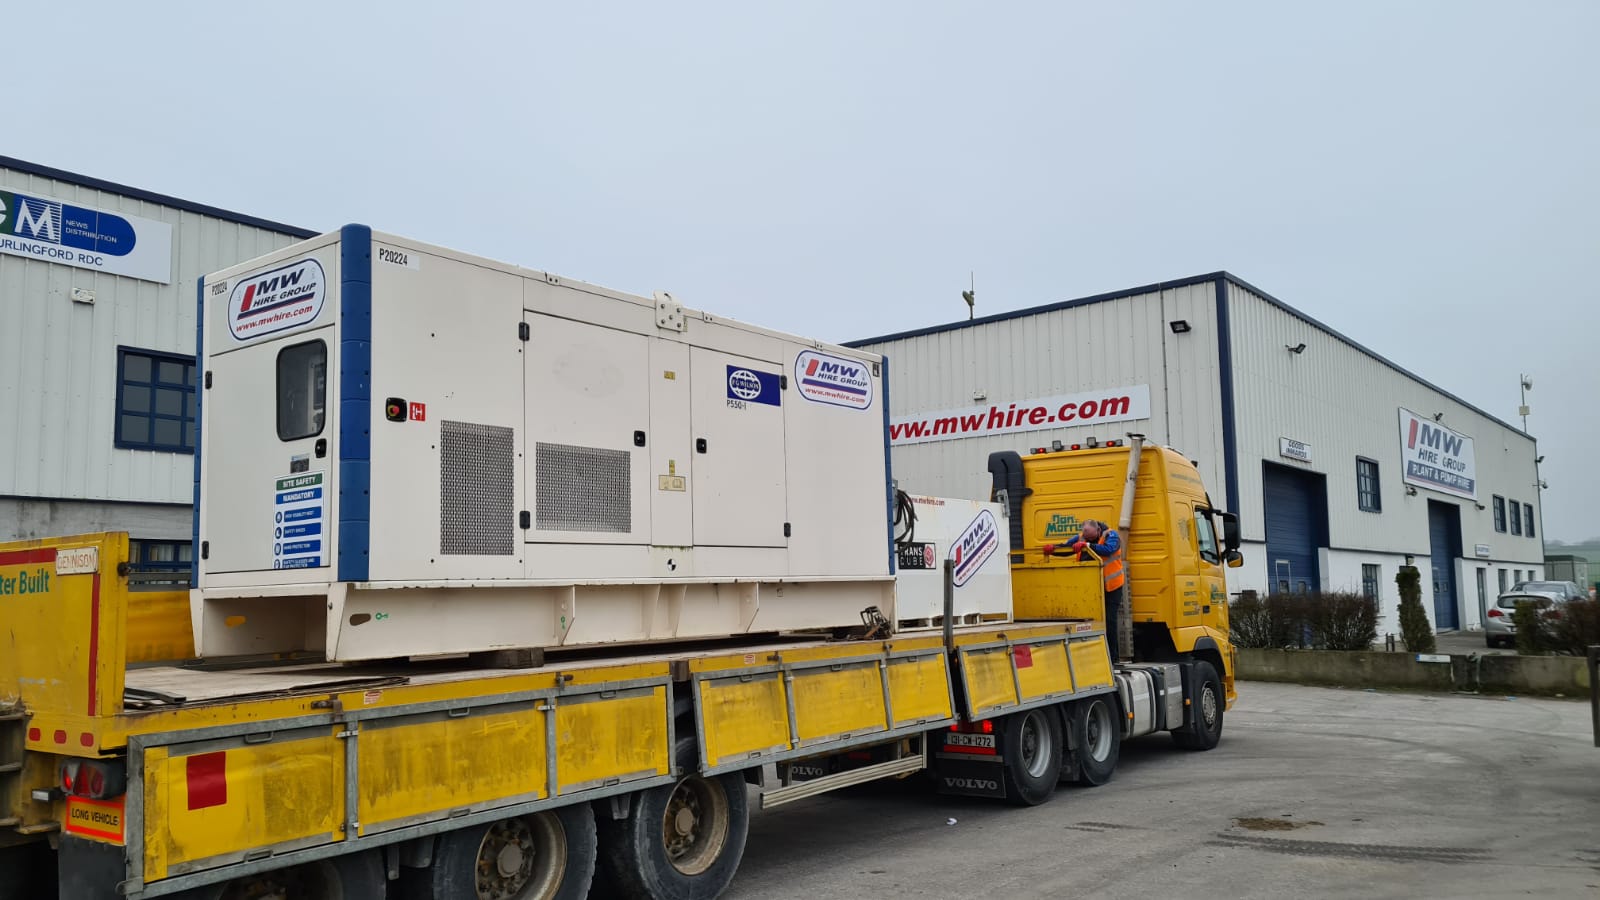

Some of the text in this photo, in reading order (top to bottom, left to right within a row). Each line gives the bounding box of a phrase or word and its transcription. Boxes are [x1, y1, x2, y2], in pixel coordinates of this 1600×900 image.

[65, 219, 89, 229] NEWS
[65, 226, 118, 243] DISTRIBUTION
[78, 253, 103, 266] RDC
[379, 247, 408, 267] P20224
[256, 268, 305, 297] MW
[253, 282, 317, 308] HIRE GROUP
[236, 305, 313, 332] www.mwhire.com
[818, 372, 868, 387] HIRE GROUP
[820, 361, 859, 378] MW
[889, 396, 1131, 441] ww.mwhire.com
[1420, 423, 1463, 457] MW
[1418, 447, 1466, 473] HIRE GROUP
[1412, 463, 1432, 479] PLANT
[1440, 472, 1457, 485] PUMP
[57, 553, 96, 570] DENNISON
[900, 556, 923, 566] CUBE
[19, 568, 50, 594] Built
[791, 765, 823, 777] OLVO
[944, 777, 998, 790] VOLVO
[71, 807, 119, 827] LONG VEHICLE
